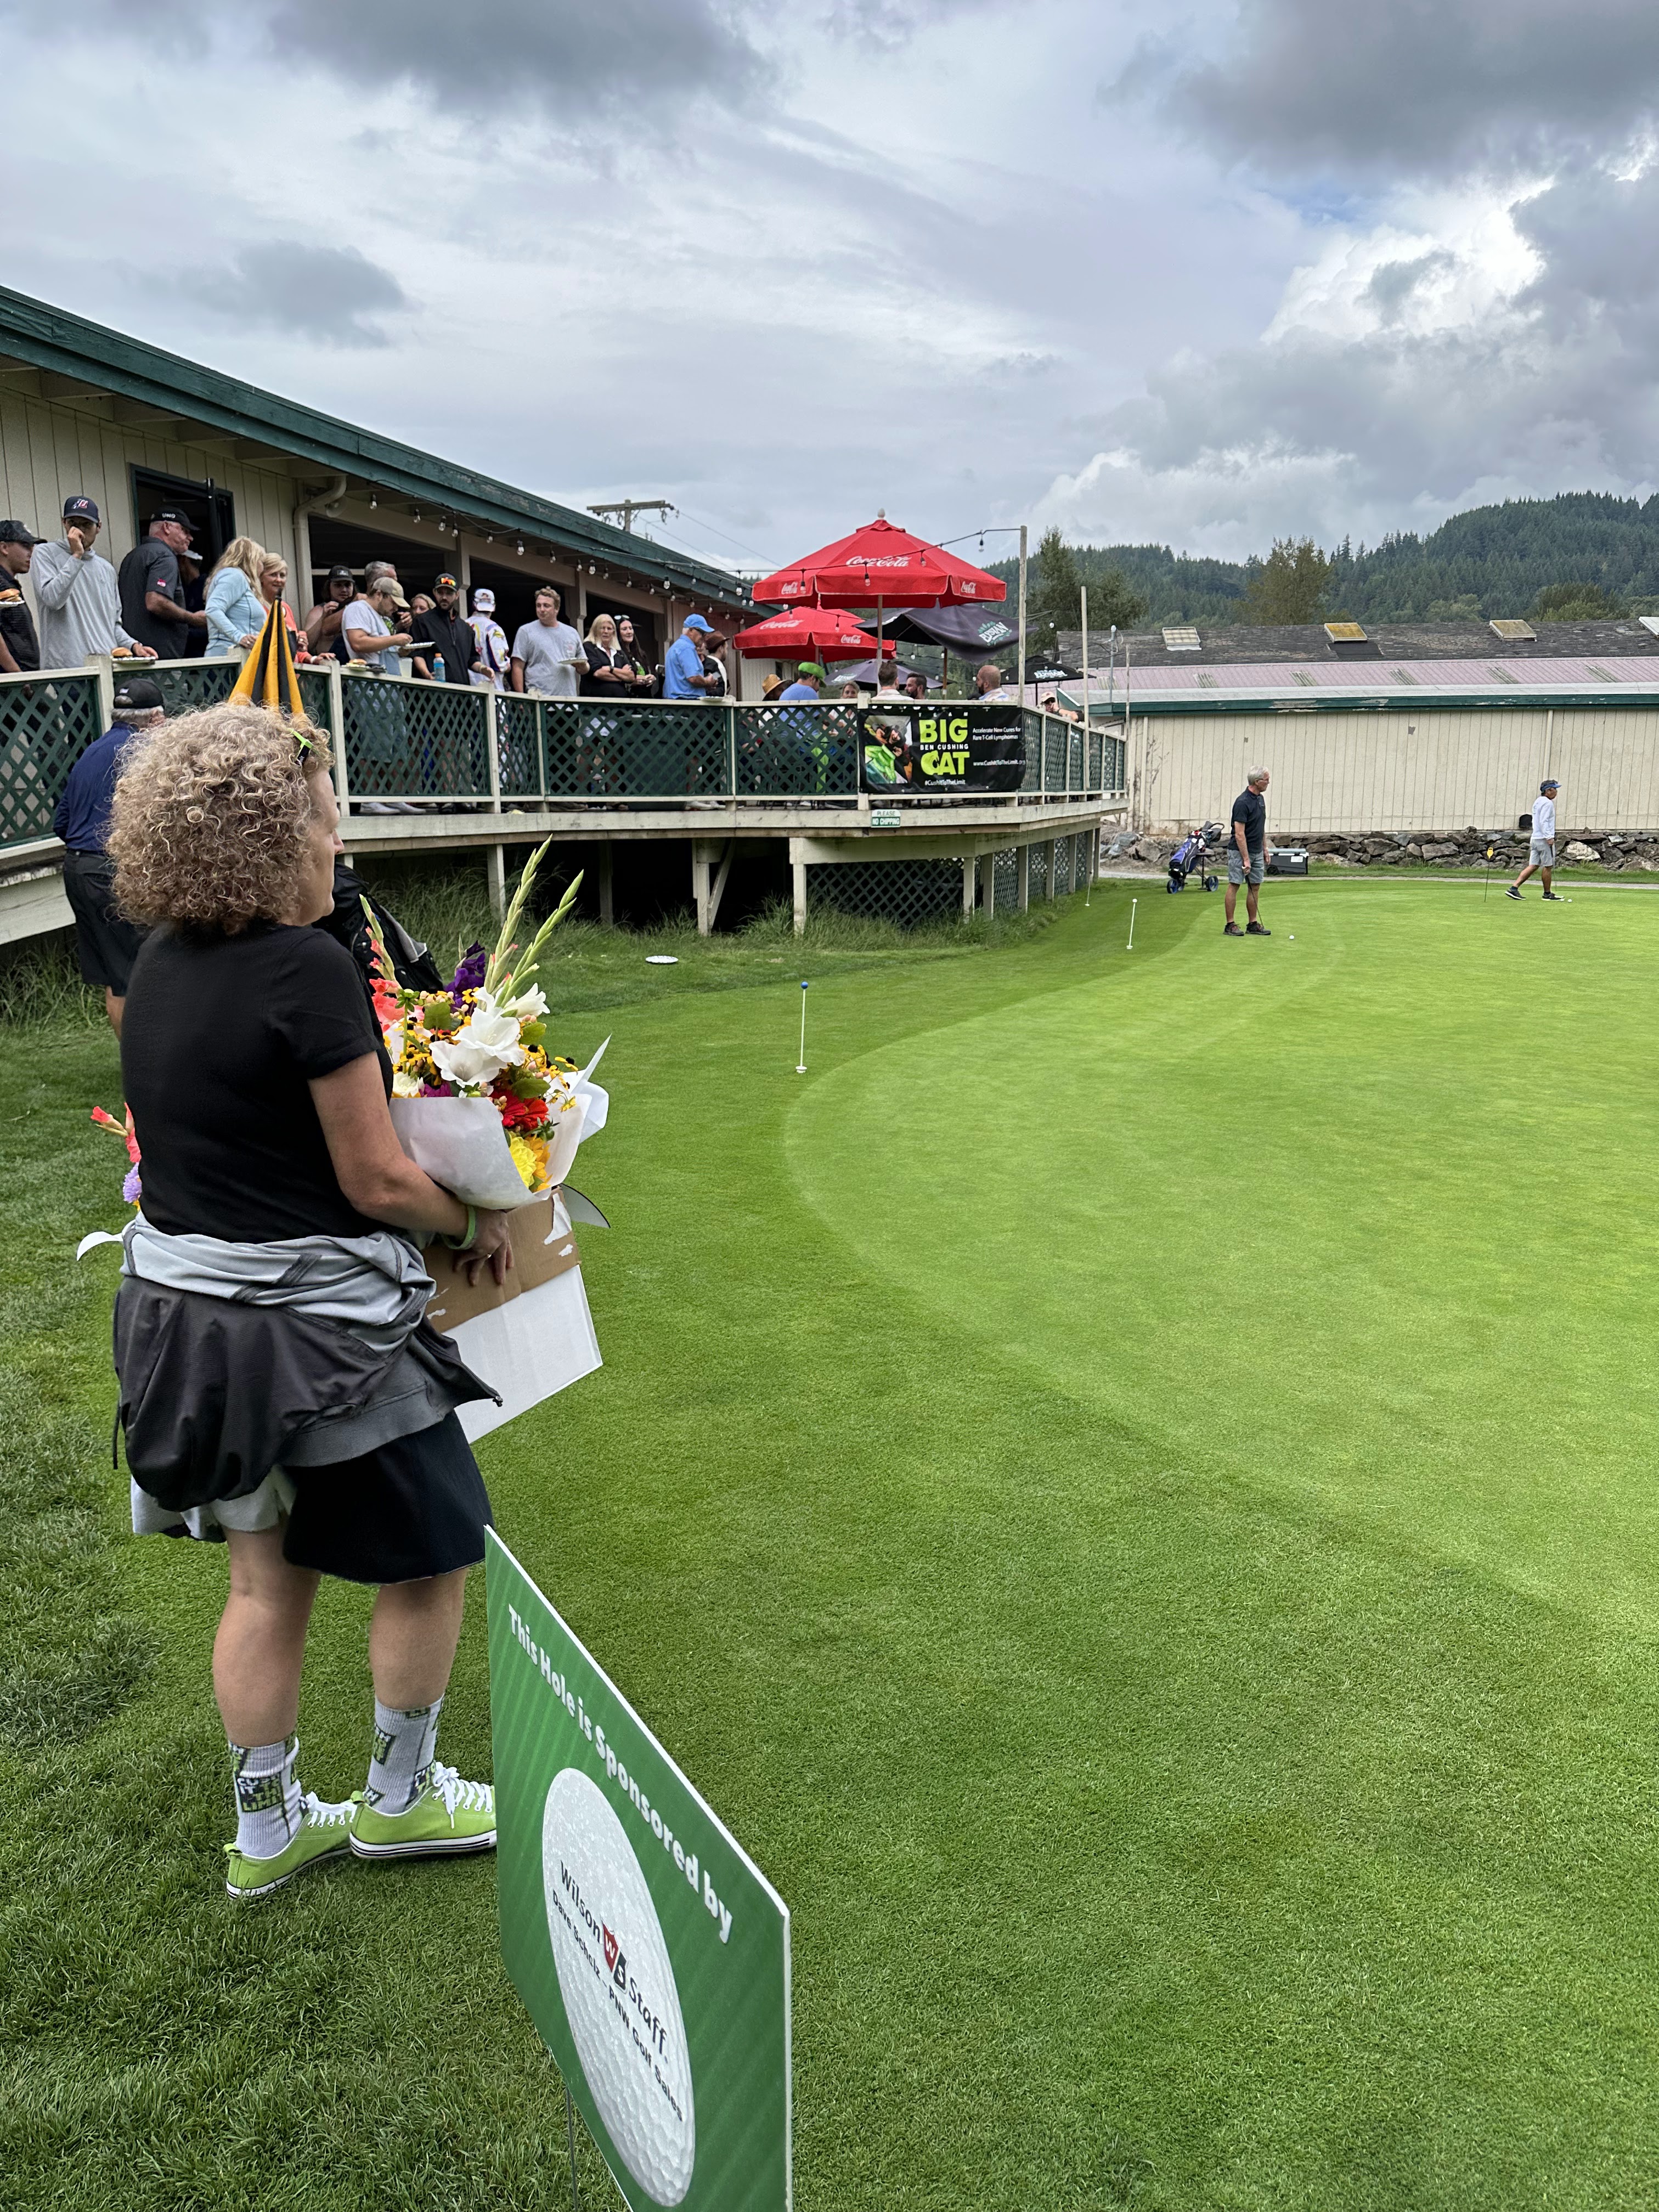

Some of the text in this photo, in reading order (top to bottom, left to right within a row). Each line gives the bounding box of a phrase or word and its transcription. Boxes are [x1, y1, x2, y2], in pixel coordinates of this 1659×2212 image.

[845, 555, 912, 567] Coca-Cola
[919, 718, 968, 743] BIG
[921, 750, 970, 775] CAT
[508, 1602, 733, 1944] This Hole is Sponsored by
[552, 1888, 572, 1930] Dave
[609, 1984, 629, 2030] PNW
[633, 2026, 652, 2068] Golf
[654, 2064, 682, 2121] Sales
[560, 1859, 601, 1944] Wilson
[629, 1977, 667, 2055] Staff
